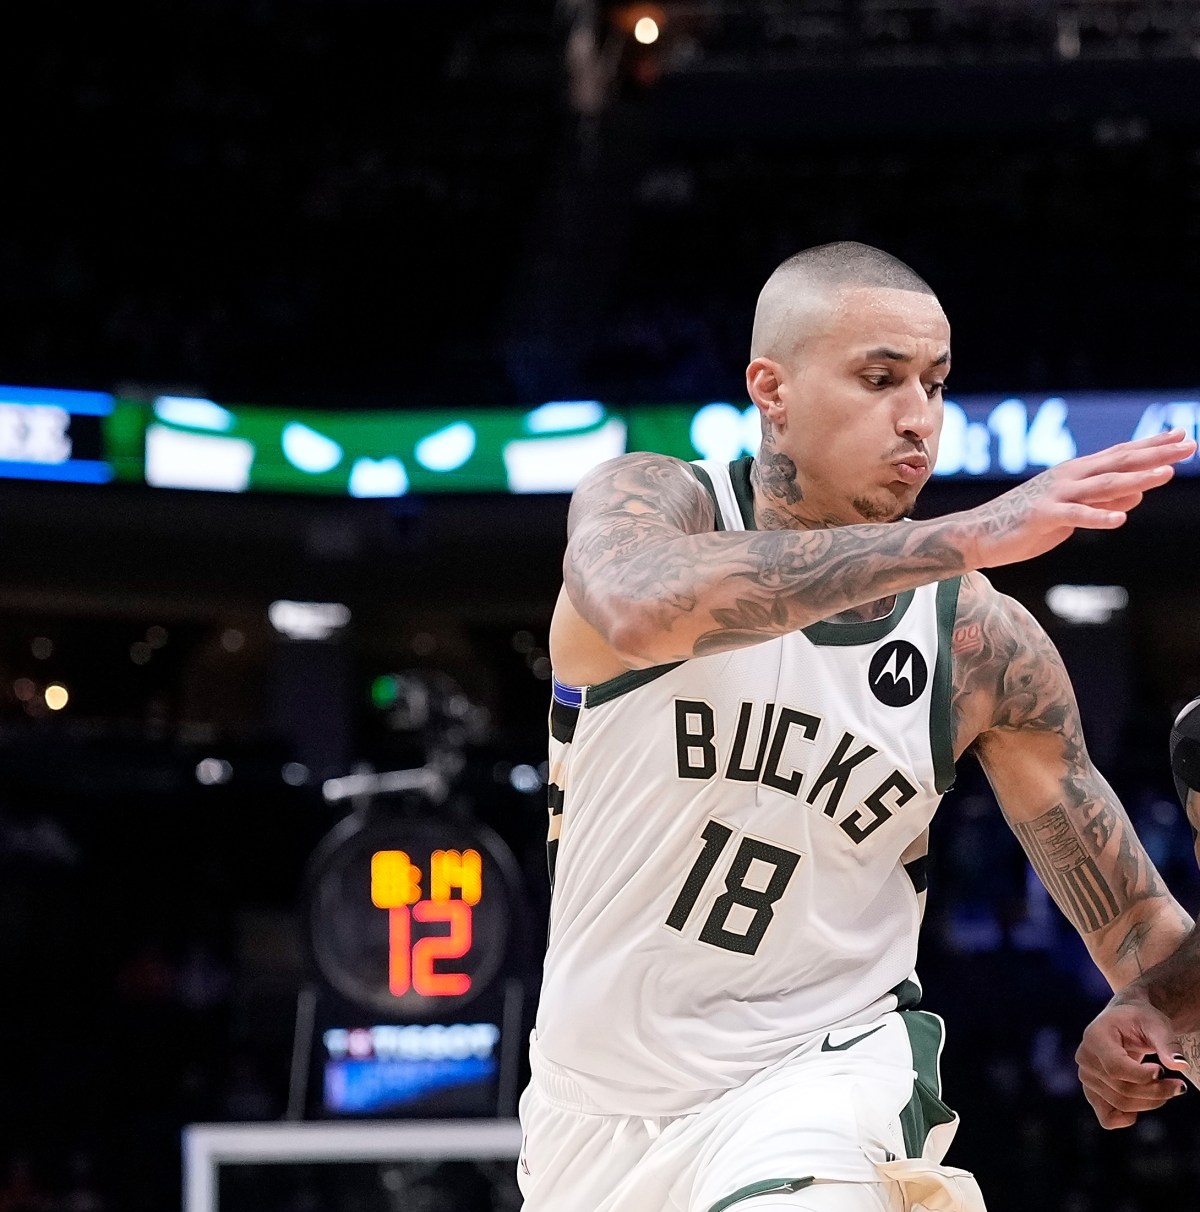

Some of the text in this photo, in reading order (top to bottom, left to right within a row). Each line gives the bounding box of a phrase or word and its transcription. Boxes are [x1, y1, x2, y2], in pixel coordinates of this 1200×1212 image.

[674, 697, 919, 846] BUCKS
[389, 900, 472, 997] 12
[664, 818, 803, 957] 18
